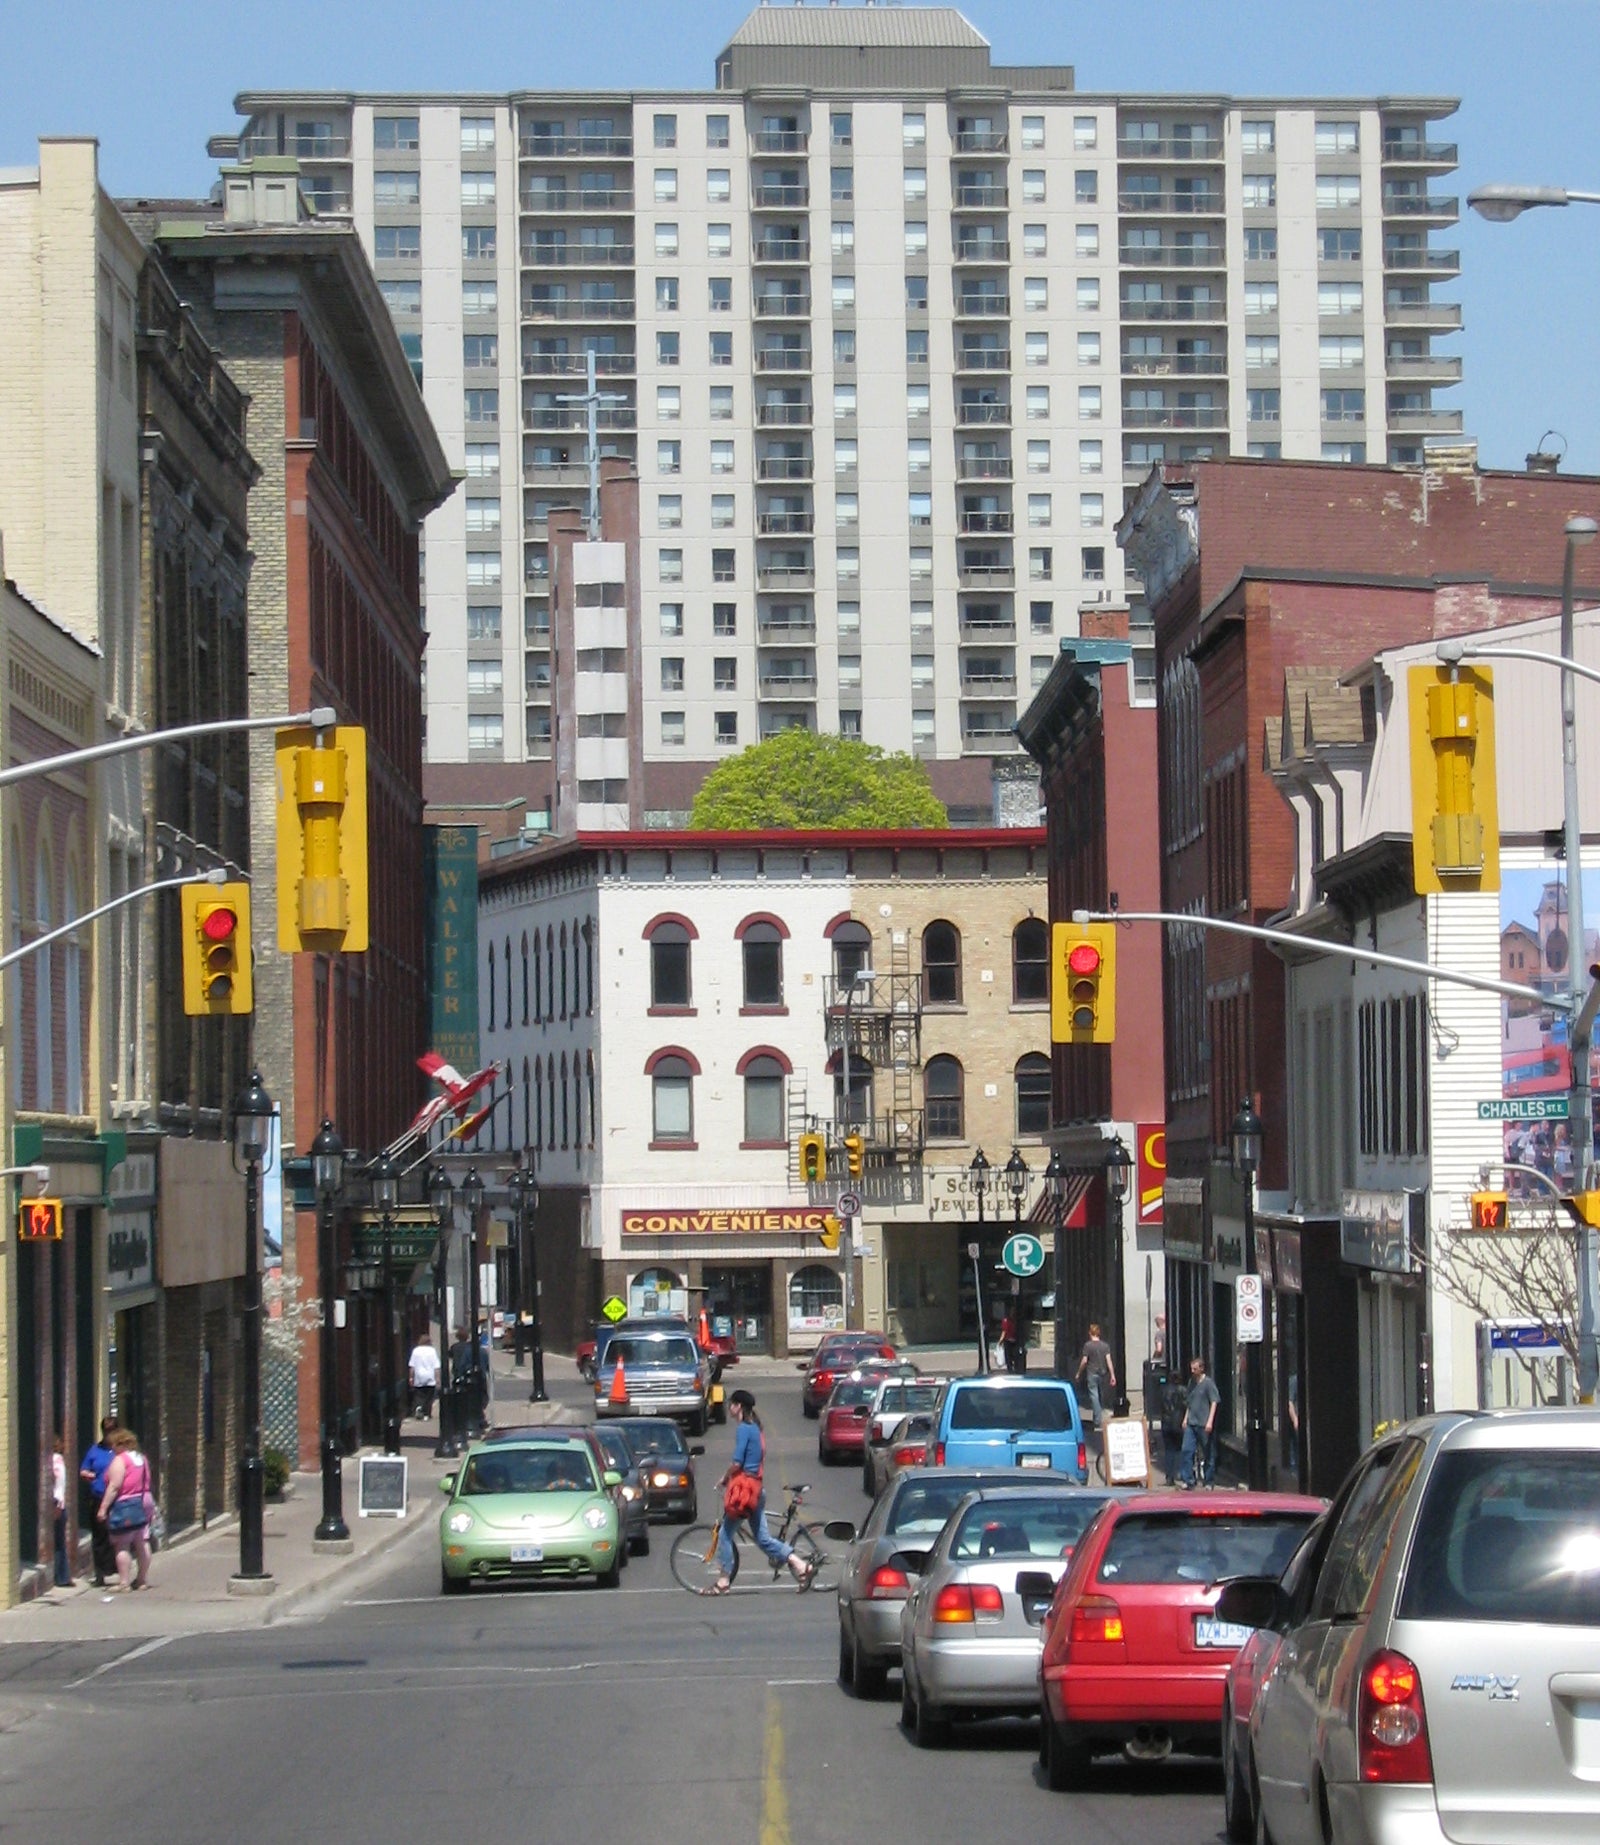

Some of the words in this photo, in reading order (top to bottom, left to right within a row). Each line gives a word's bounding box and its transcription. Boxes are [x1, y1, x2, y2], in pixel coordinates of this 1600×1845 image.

[440, 870, 461, 1013] WALPER
[1480, 1101, 1546, 1117] CHARLES
[933, 1198, 1027, 1212] JEWELERS
[1450, 1674, 1521, 1691] MPV
